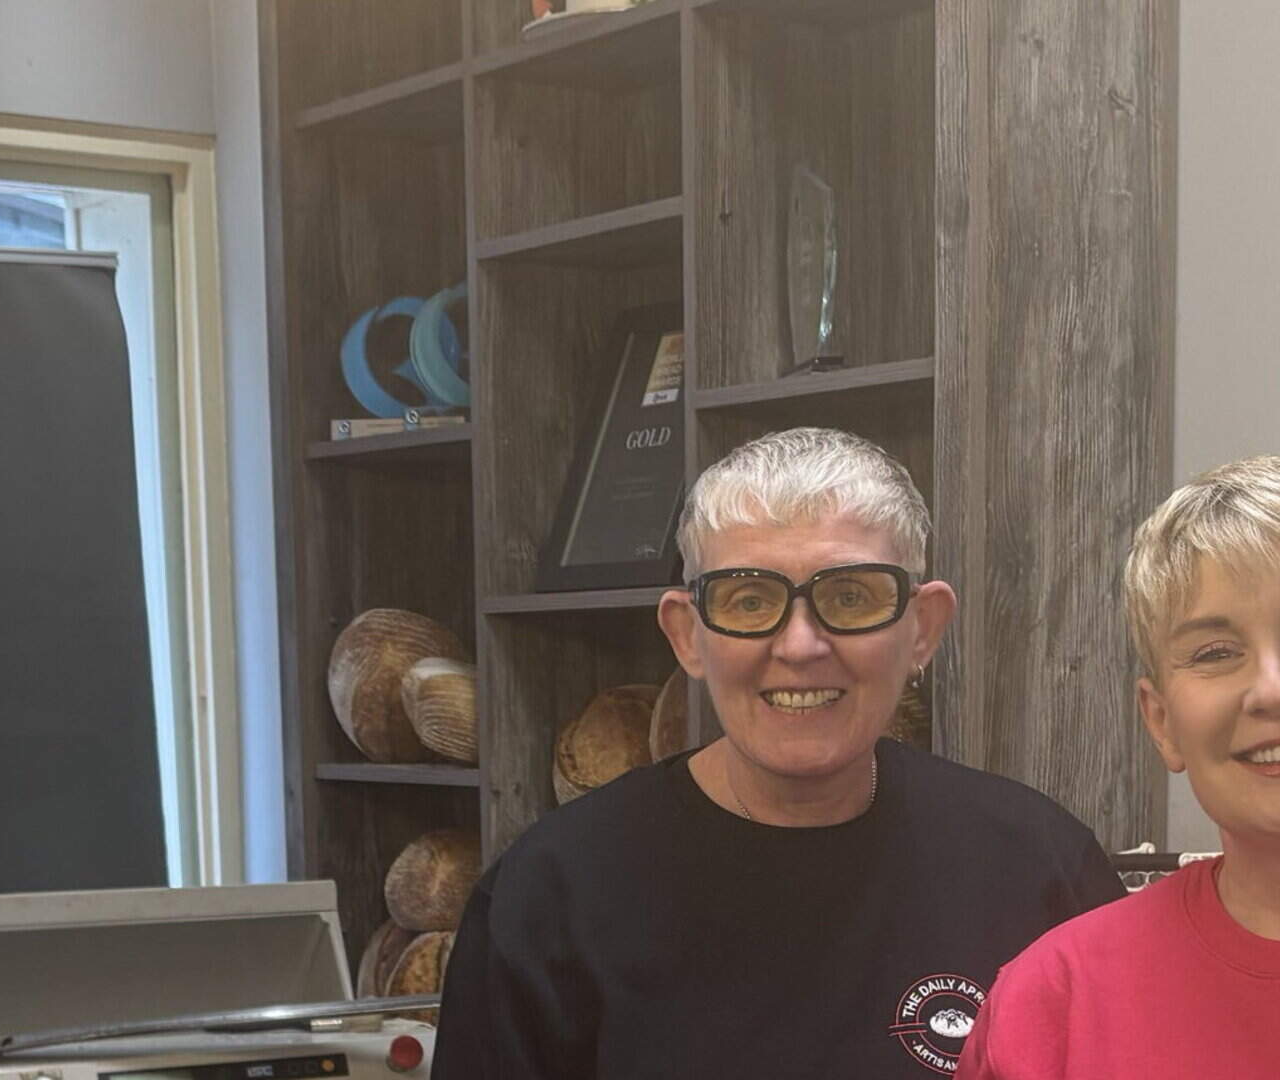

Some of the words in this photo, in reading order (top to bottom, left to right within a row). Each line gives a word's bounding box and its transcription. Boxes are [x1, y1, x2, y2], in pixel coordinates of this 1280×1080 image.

[625, 426, 671, 450] GOLD
[902, 992, 923, 1018] THE
[918, 978, 956, 997] DAILY
[957, 980, 986, 1006] APR
